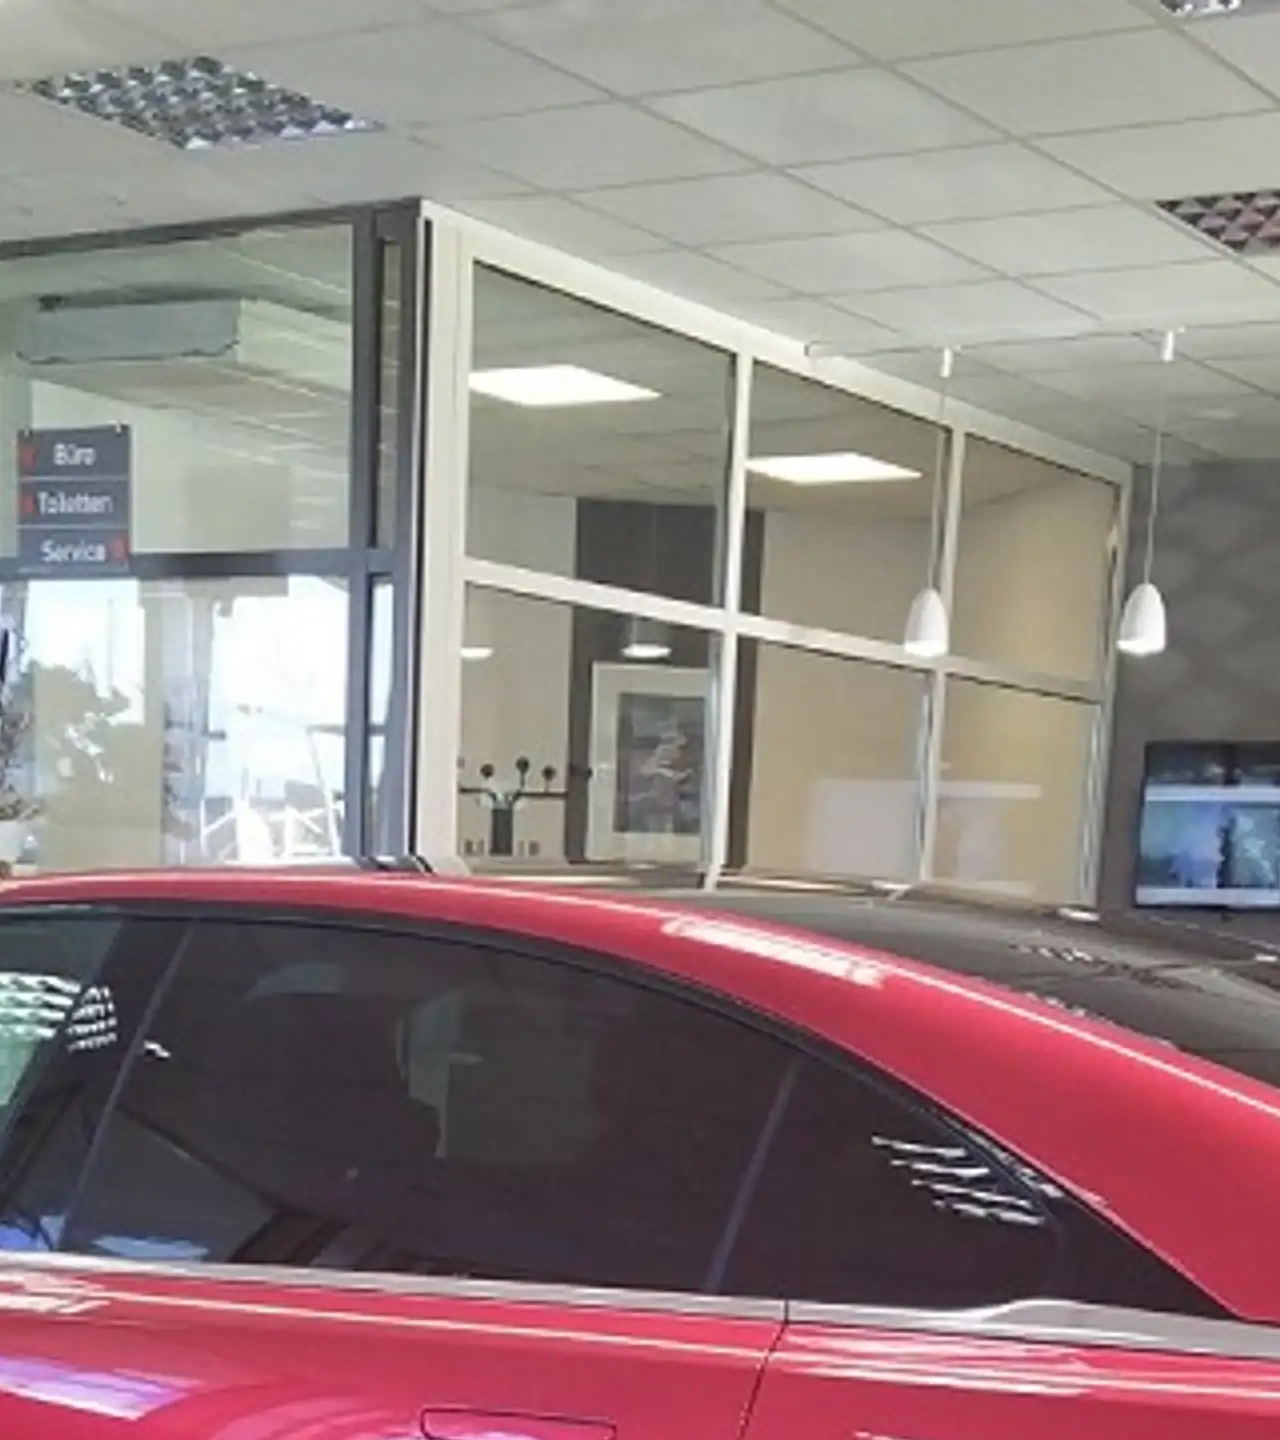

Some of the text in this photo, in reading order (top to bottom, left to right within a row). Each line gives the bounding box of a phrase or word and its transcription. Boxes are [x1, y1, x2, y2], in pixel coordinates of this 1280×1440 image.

[52, 443, 96, 466] Büro
[38, 491, 114, 514] Toiletten
[41, 540, 106, 563] Service
